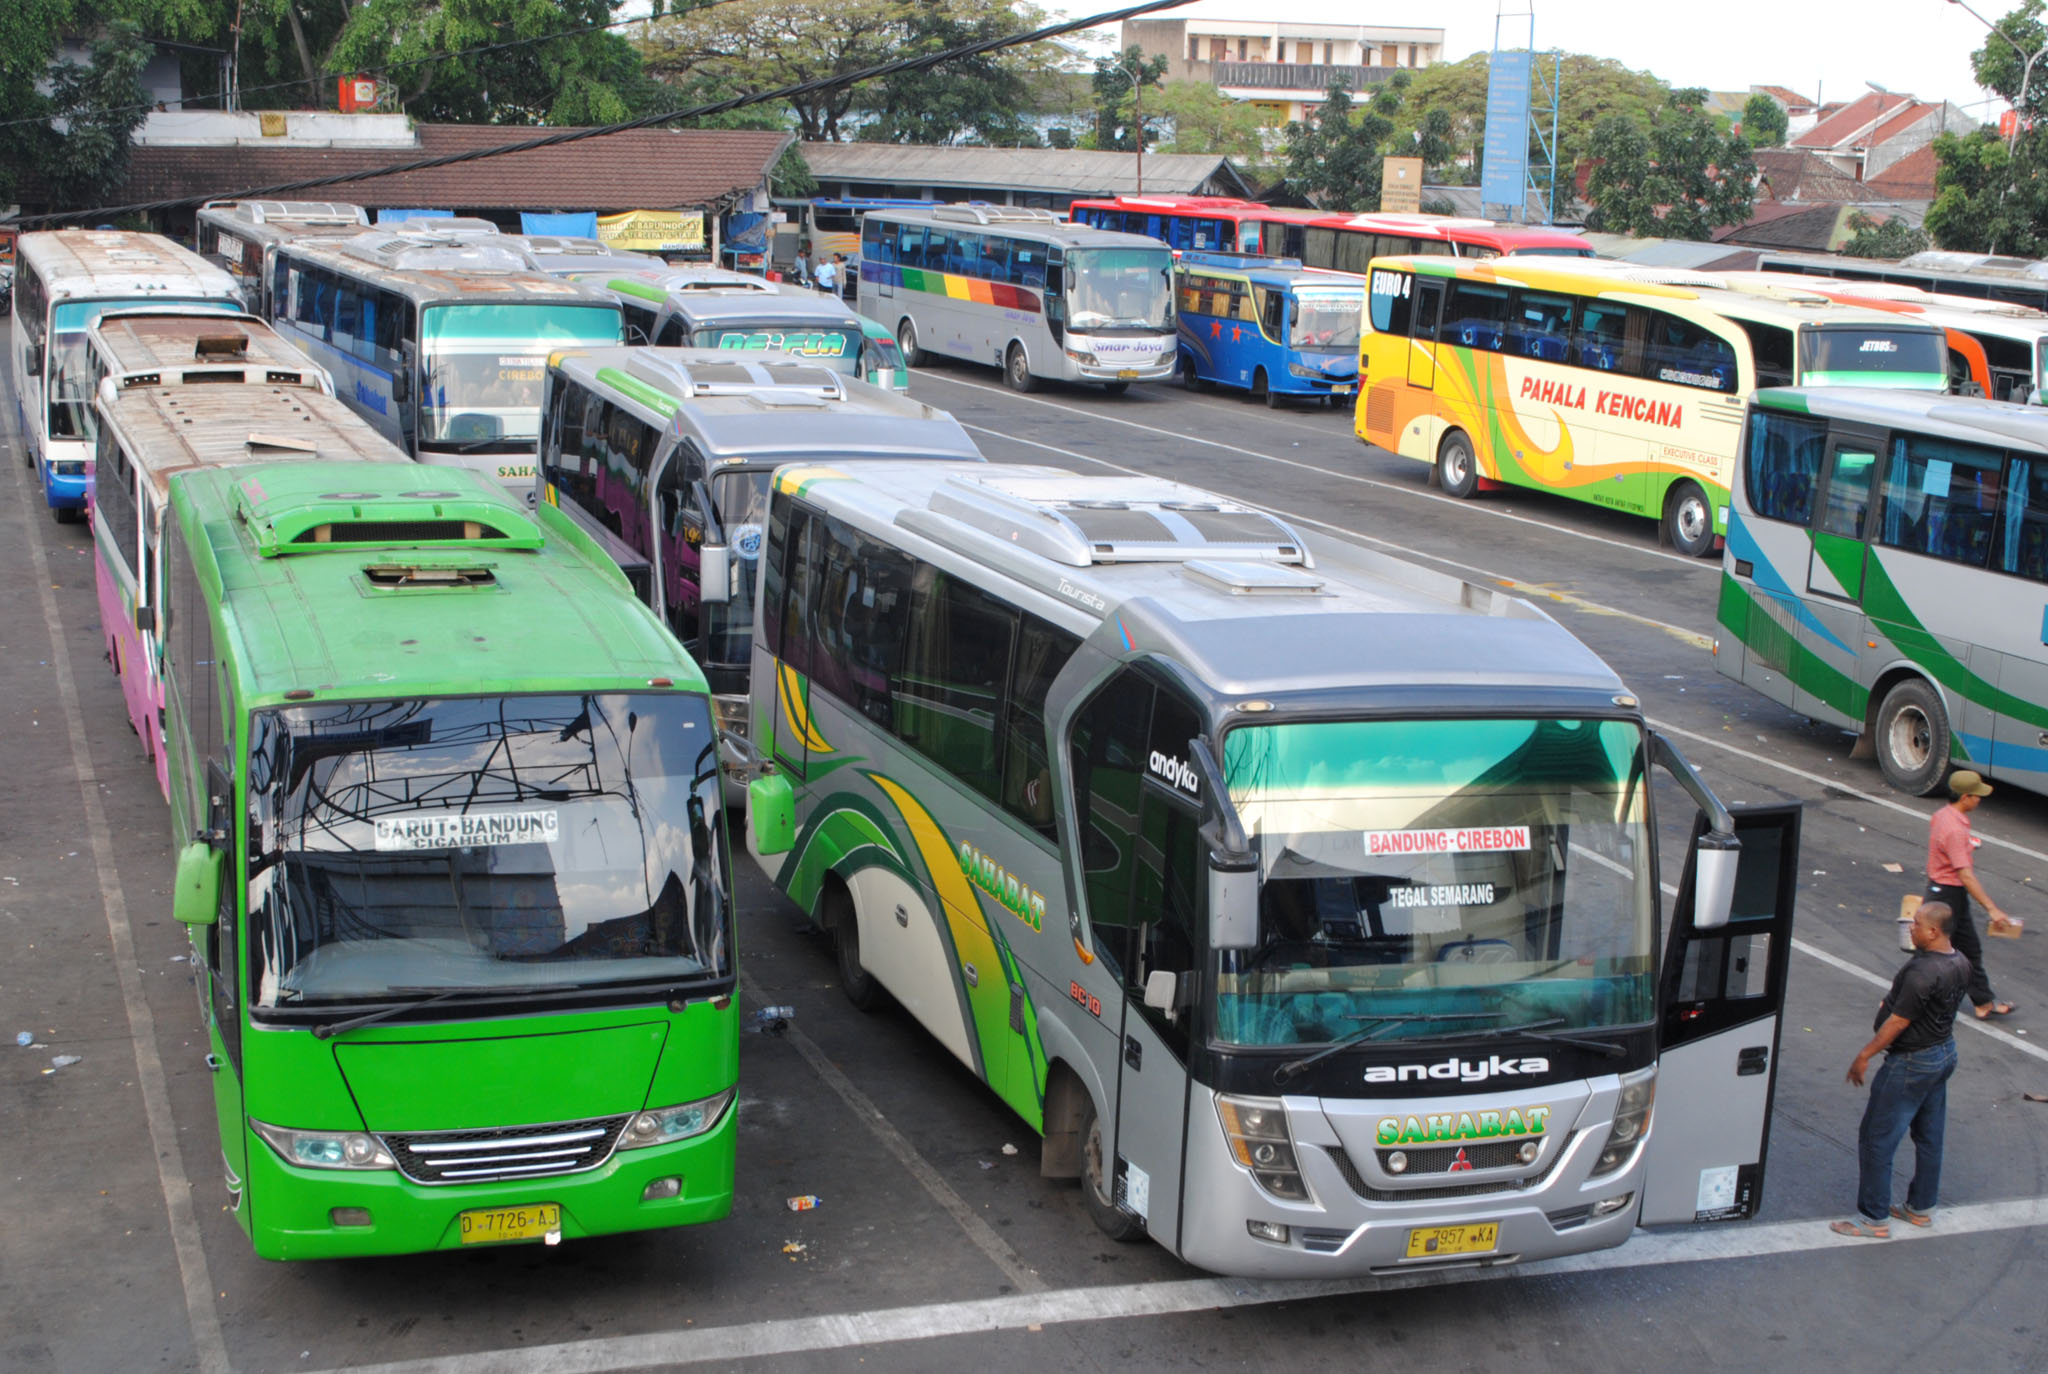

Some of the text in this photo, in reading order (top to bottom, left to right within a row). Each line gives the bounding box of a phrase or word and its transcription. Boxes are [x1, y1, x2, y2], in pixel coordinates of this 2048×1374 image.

[1373, 270, 1411, 299] EURO 4
[1093, 341, 1163, 353] Sinar Jaya
[1520, 376, 1683, 429] PAHALA KENCANA
[1663, 446, 1718, 466] EXECUTIVE CLASS
[1058, 577, 1105, 611] Tourista
[1150, 750, 1198, 793] andyka
[414, 834, 510, 849] CICAHEUM
[960, 839, 1046, 933] SAHABAT
[1390, 883, 1494, 908] TEGAL SEMARANG
[1070, 980, 1102, 1018] BC 10
[1363, 1055, 1550, 1083] andyka
[1376, 1105, 1551, 1146] SAHABAT
[462, 1208, 558, 1233] D 7726 AJ
[1411, 1226, 1493, 1248] E 7957 KA
